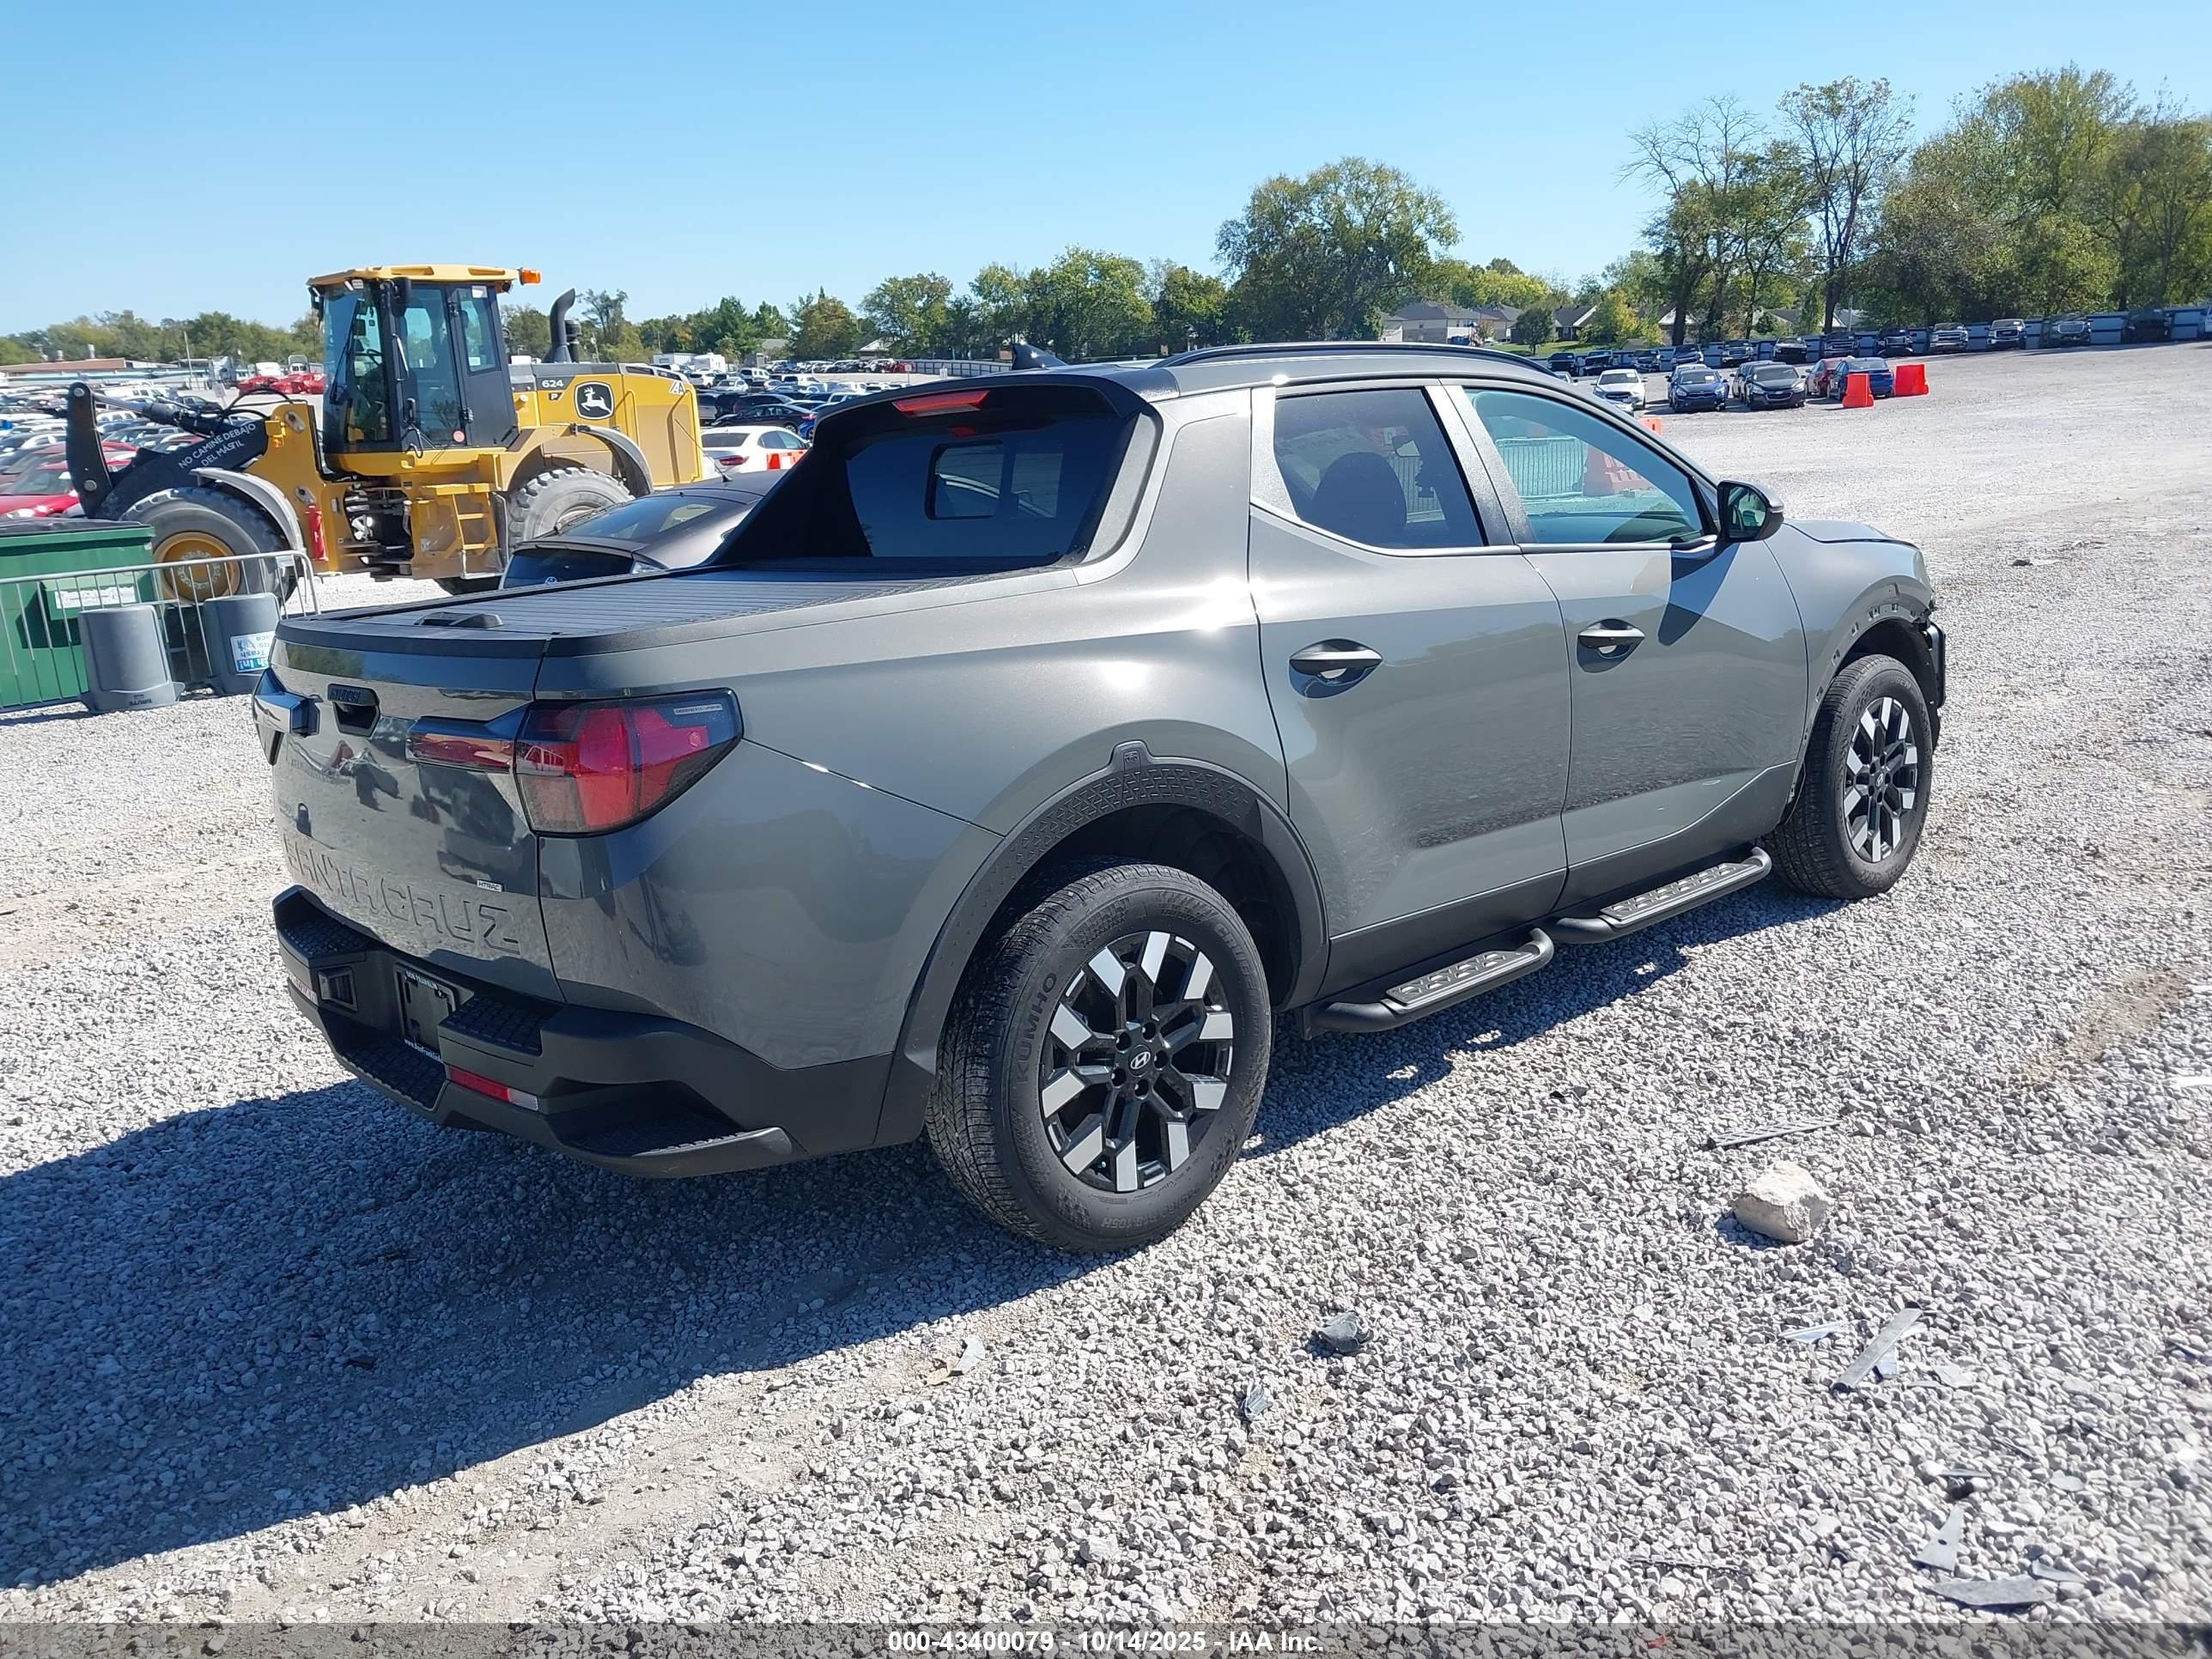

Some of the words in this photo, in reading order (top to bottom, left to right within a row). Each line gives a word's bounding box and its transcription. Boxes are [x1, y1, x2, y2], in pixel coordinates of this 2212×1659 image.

[542, 380, 564, 388] 624
[178, 456, 193, 469] NO
[192, 434, 223, 459] CAMINE
[222, 422, 257, 441] DEBAJO
[200, 453, 218, 466] DEL
[477, 880, 502, 891] HTRAC
[380, 877, 521, 956] CRUZ
[1015, 972, 1058, 1084] KUMHO
